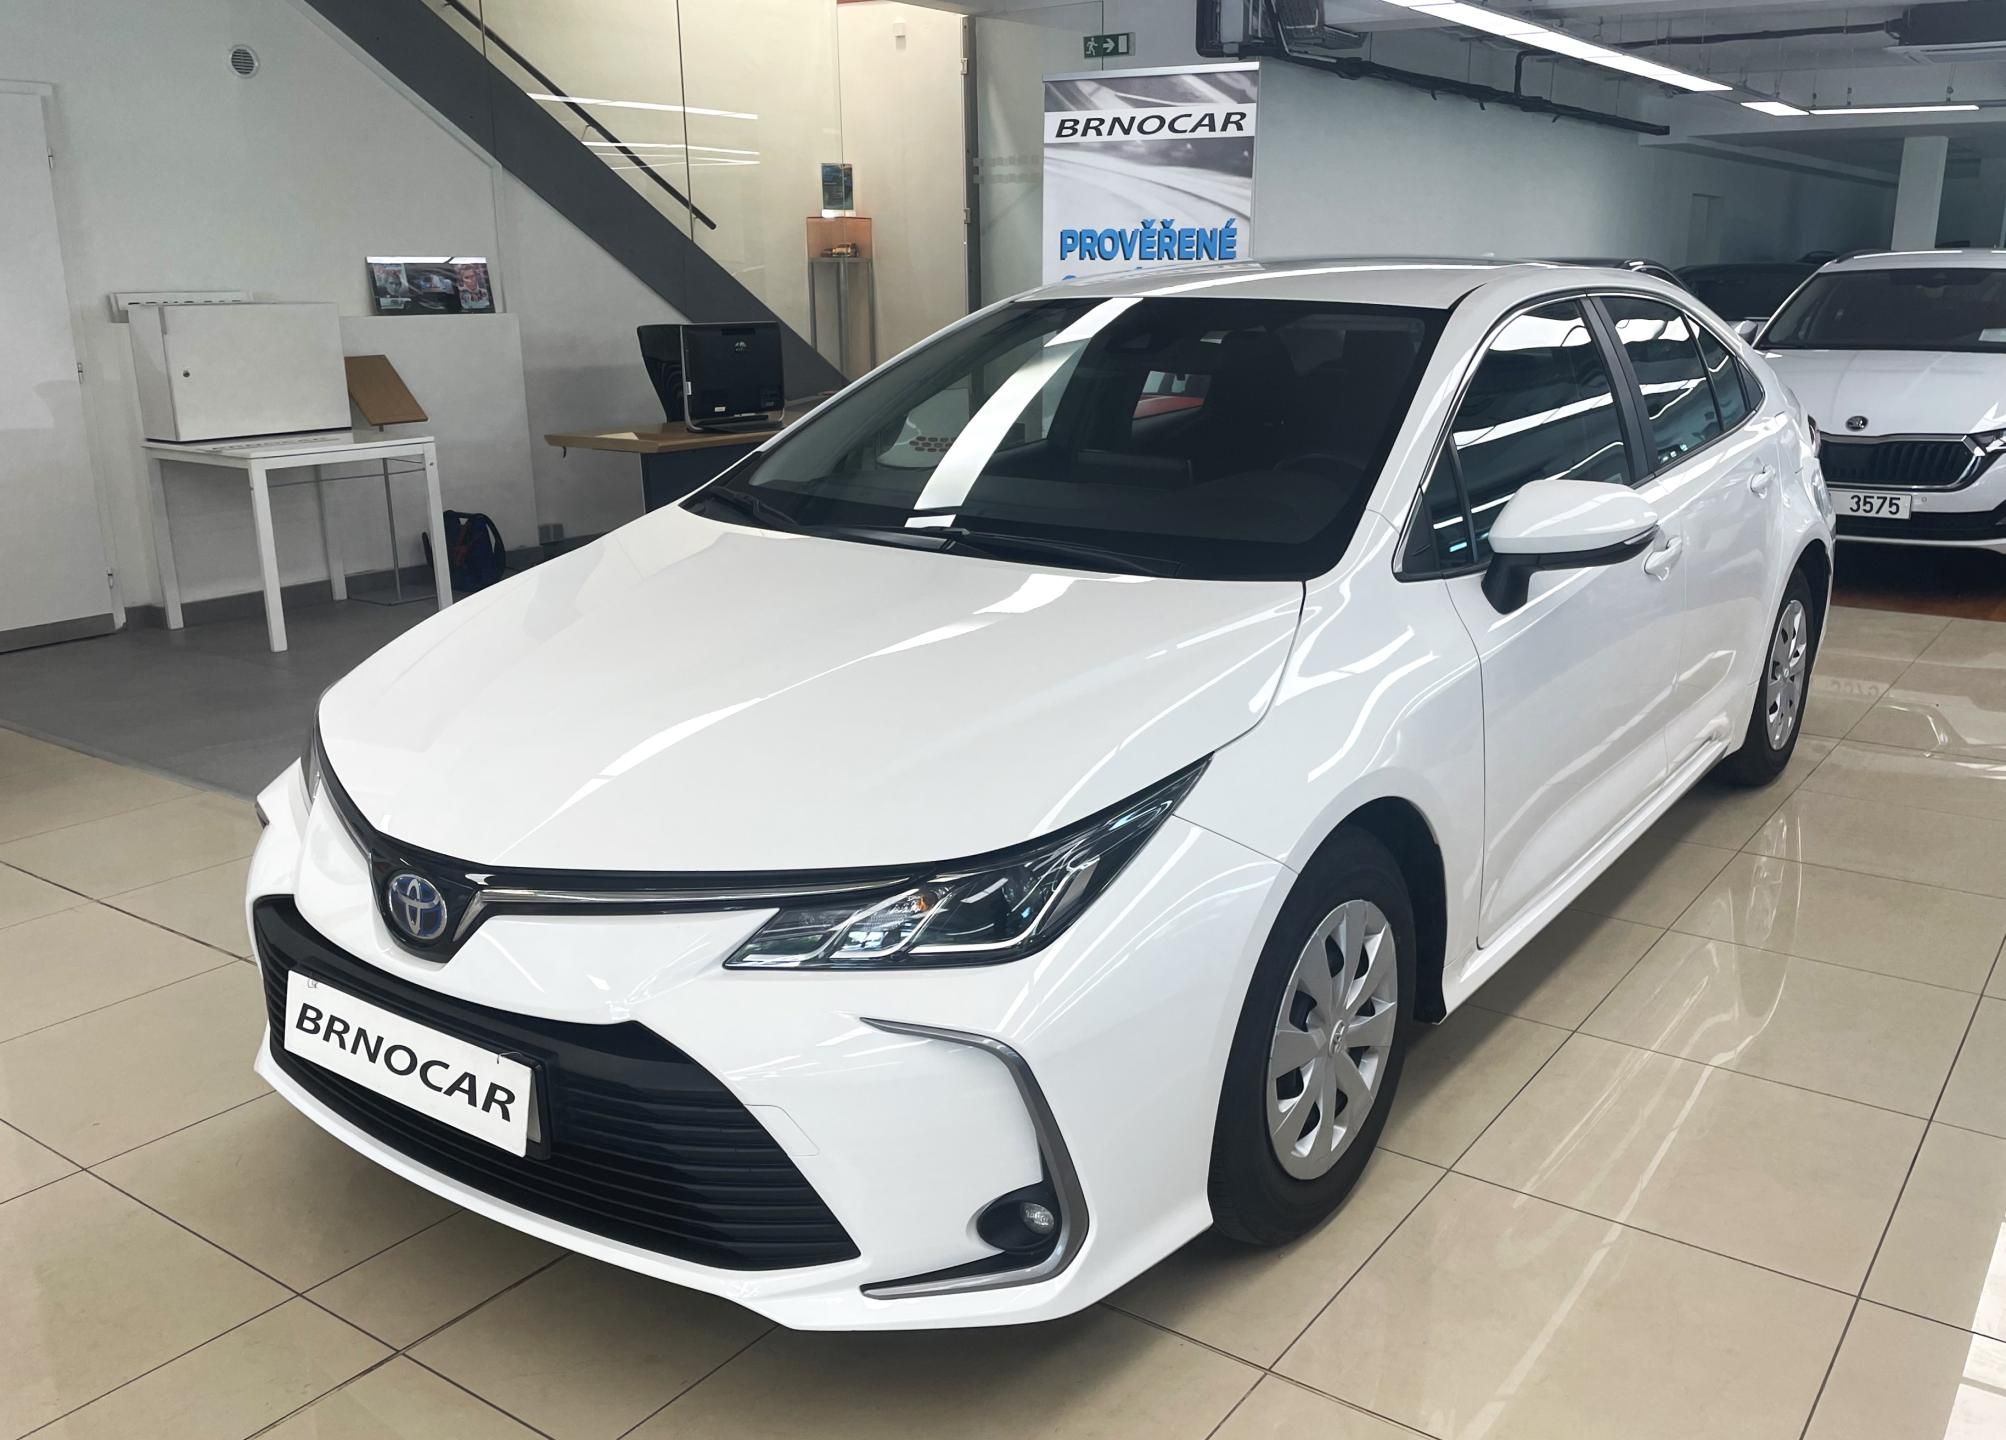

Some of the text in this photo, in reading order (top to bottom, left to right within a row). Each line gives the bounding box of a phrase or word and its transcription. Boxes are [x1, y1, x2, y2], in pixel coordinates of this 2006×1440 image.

[1055, 112, 1247, 138] BRNOCAR
[1059, 218, 1238, 261] PROVĚŘENÉ
[1849, 494, 1901, 516] 3575
[295, 1002, 517, 1123] BRNOCAR
